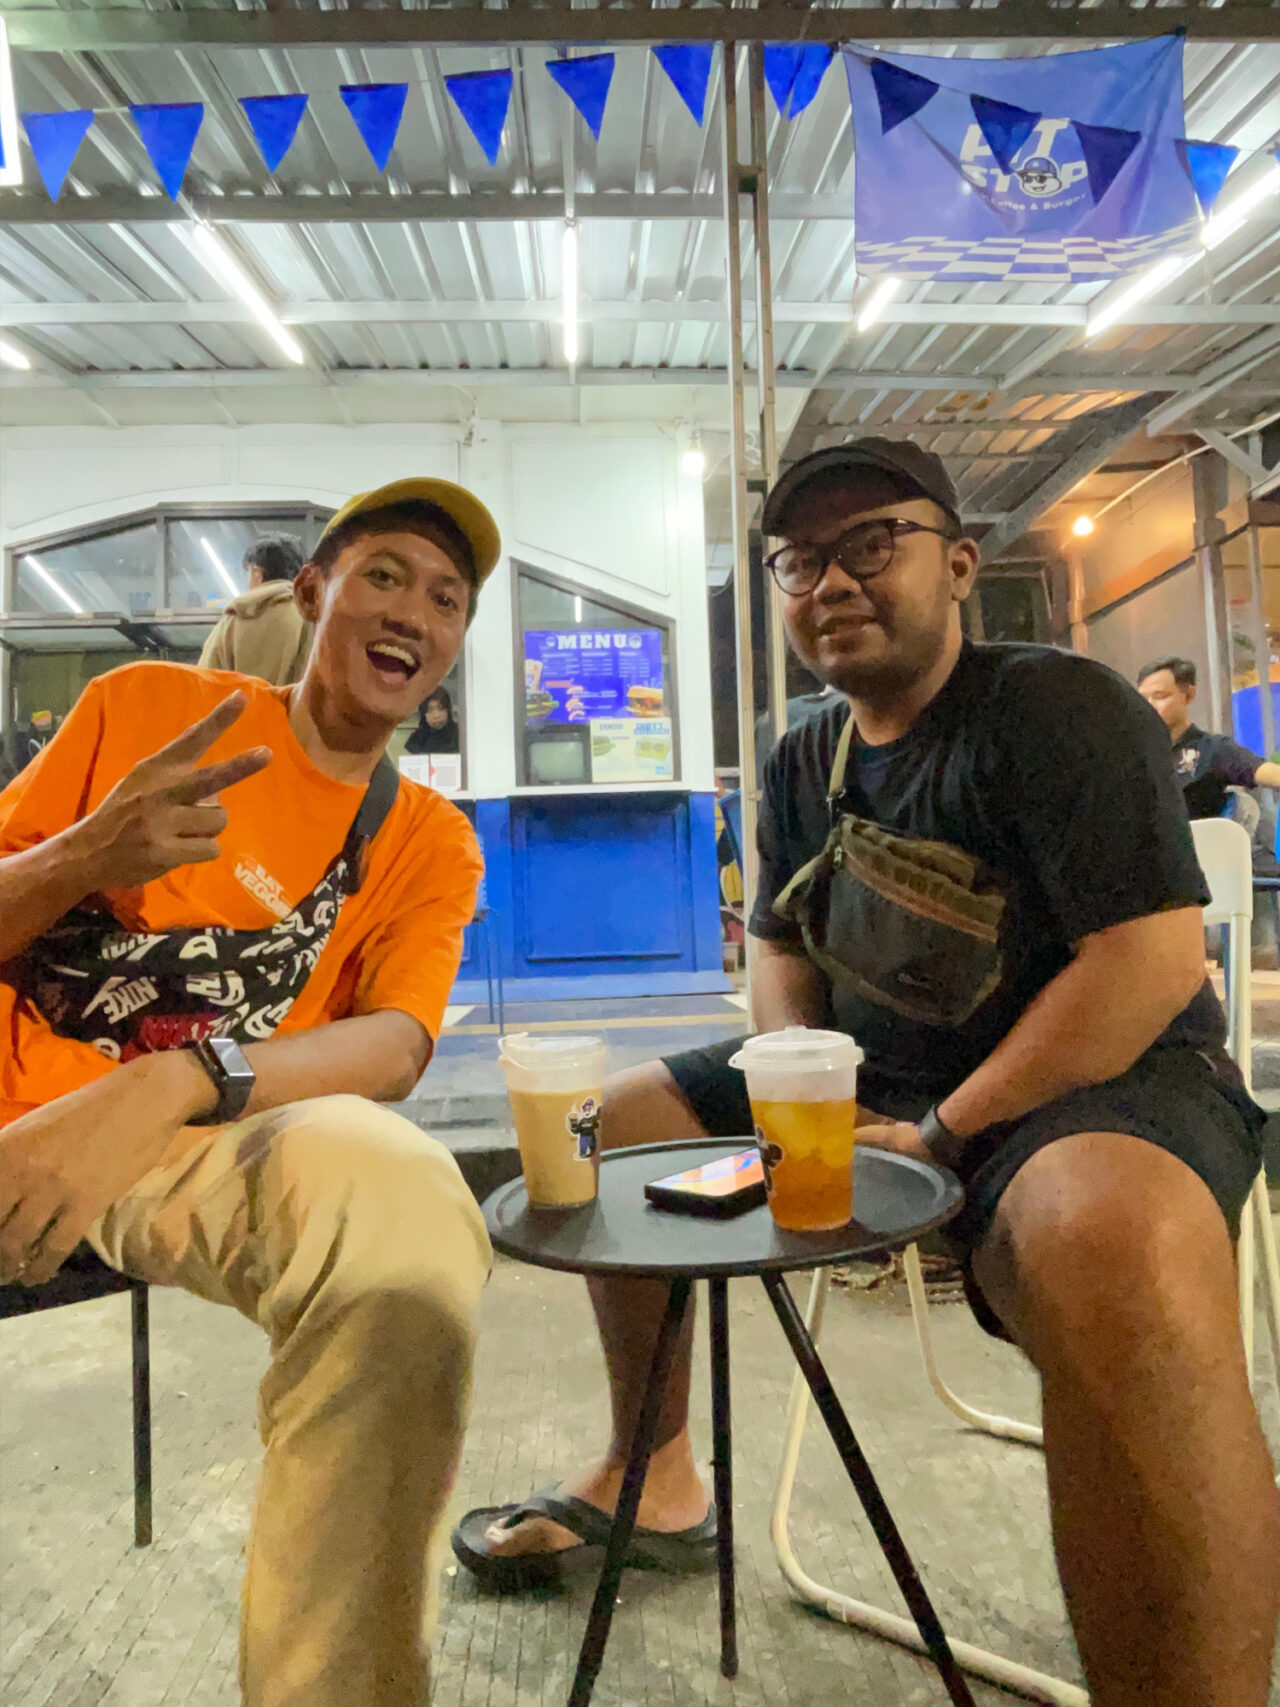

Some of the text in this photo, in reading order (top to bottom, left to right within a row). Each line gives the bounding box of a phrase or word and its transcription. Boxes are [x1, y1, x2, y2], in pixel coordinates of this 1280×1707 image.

[960, 117, 1070, 163] PT
[557, 633, 627, 650] MENU
[103, 976, 160, 1025] NIKE
